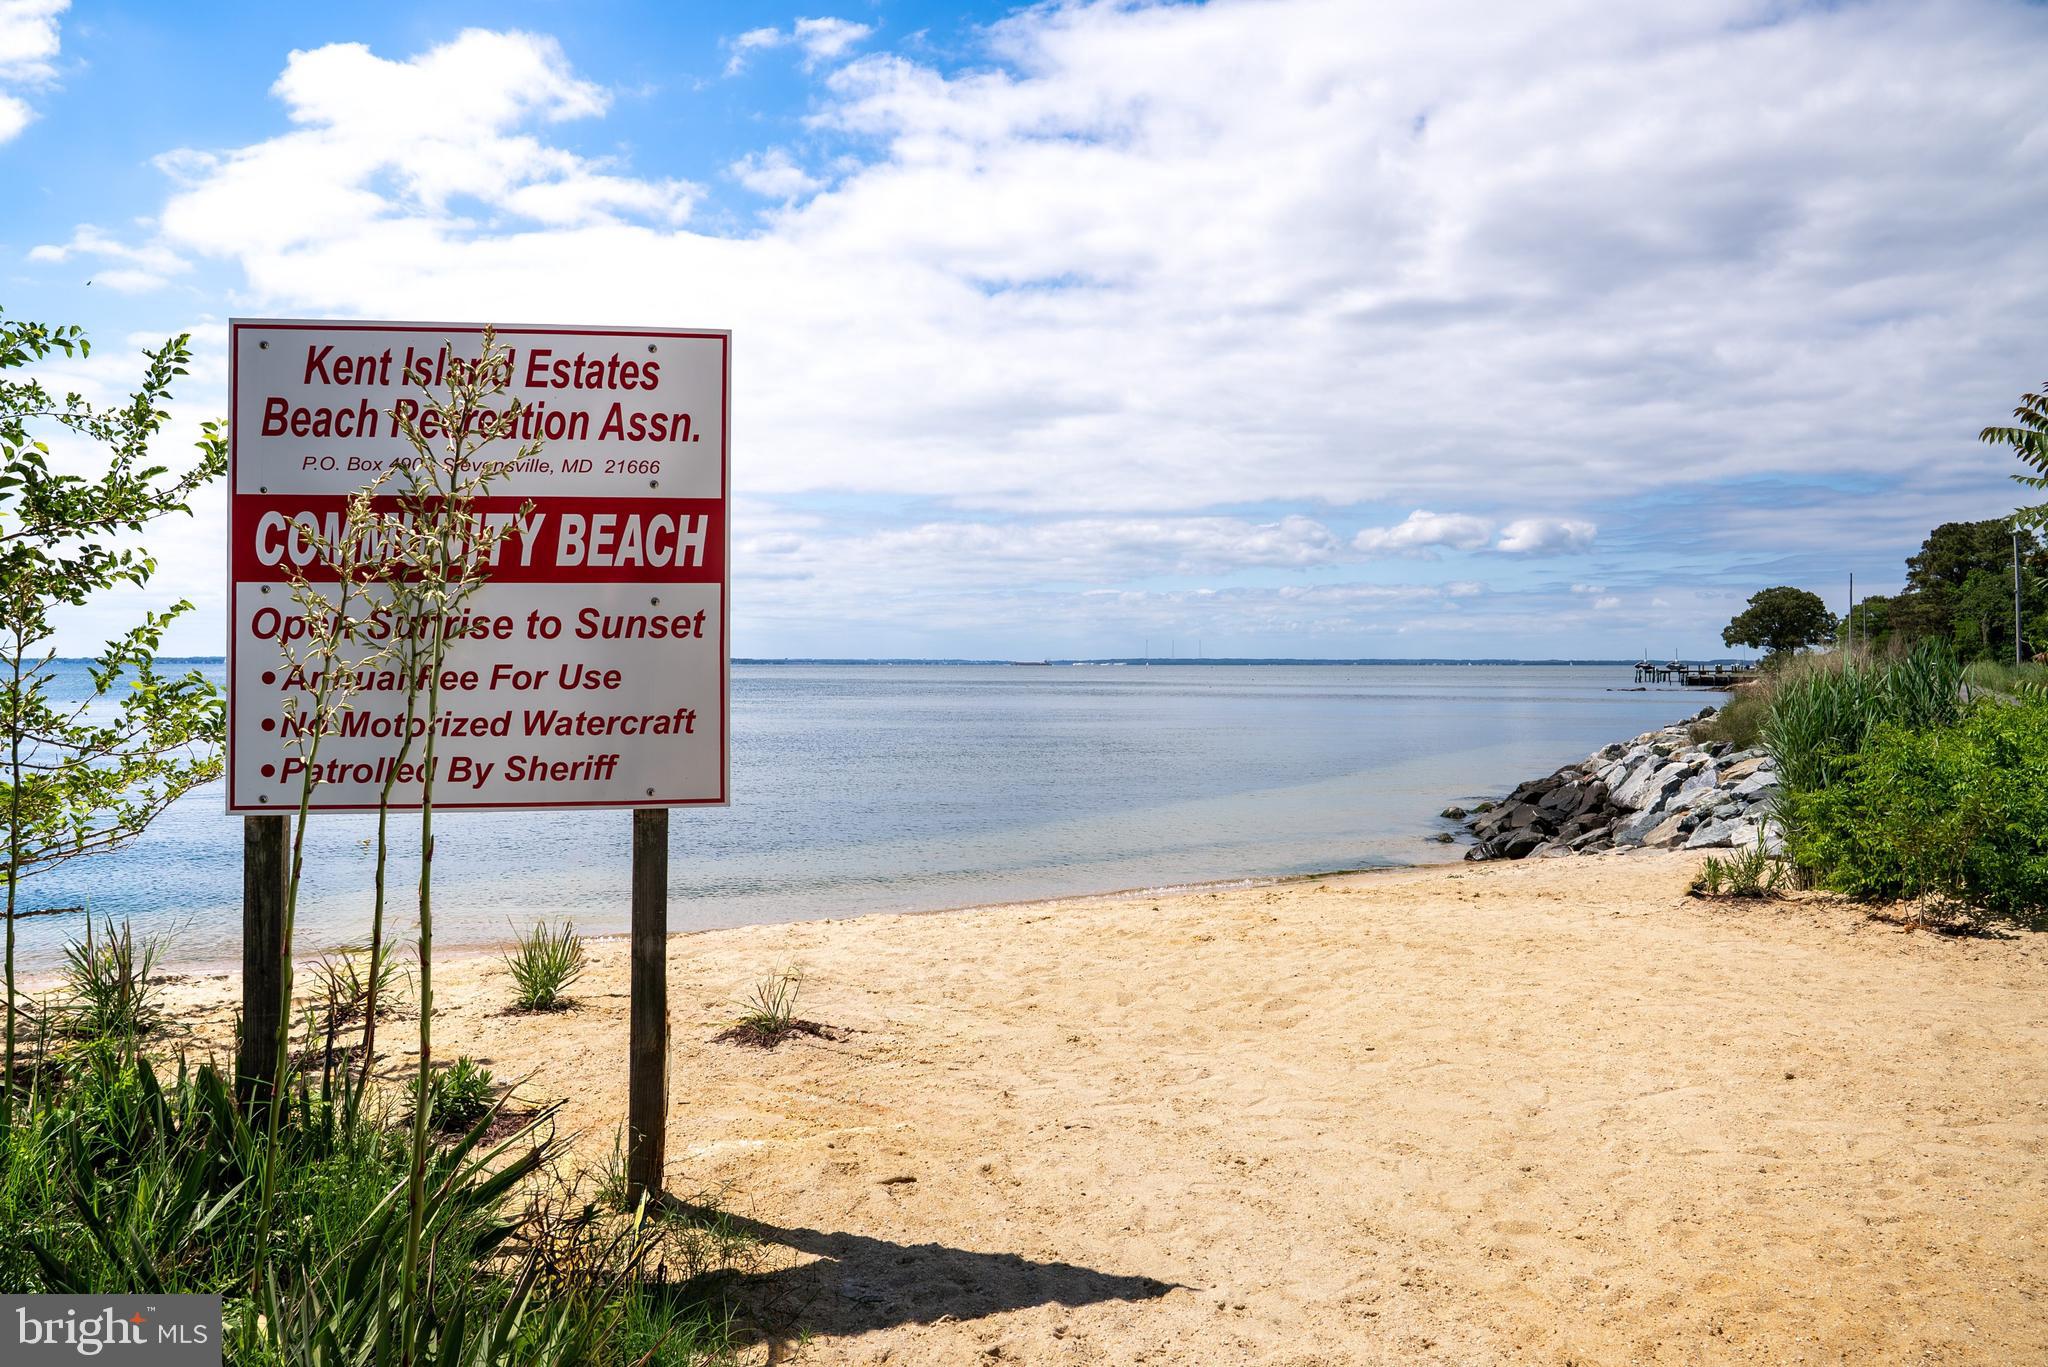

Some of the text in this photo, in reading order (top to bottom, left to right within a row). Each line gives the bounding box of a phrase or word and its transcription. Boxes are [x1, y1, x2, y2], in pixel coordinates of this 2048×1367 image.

[303, 344, 392, 386] Kent
[525, 349, 661, 391] Estates
[261, 396, 378, 438] Beach
[599, 402, 701, 443] Assn.
[302, 456, 339, 471] P.O.
[347, 457, 383, 471] Box
[561, 459, 593, 473] MD
[605, 459, 661, 474] 21666
[556, 513, 708, 567] BEACH
[526, 609, 562, 640] to
[574, 608, 705, 640] Sunset
[489, 664, 548, 691] For
[558, 664, 622, 690] Use
[523, 708, 696, 737] Watercraft
[447, 756, 493, 789] By
[504, 753, 620, 782] Sheriff
